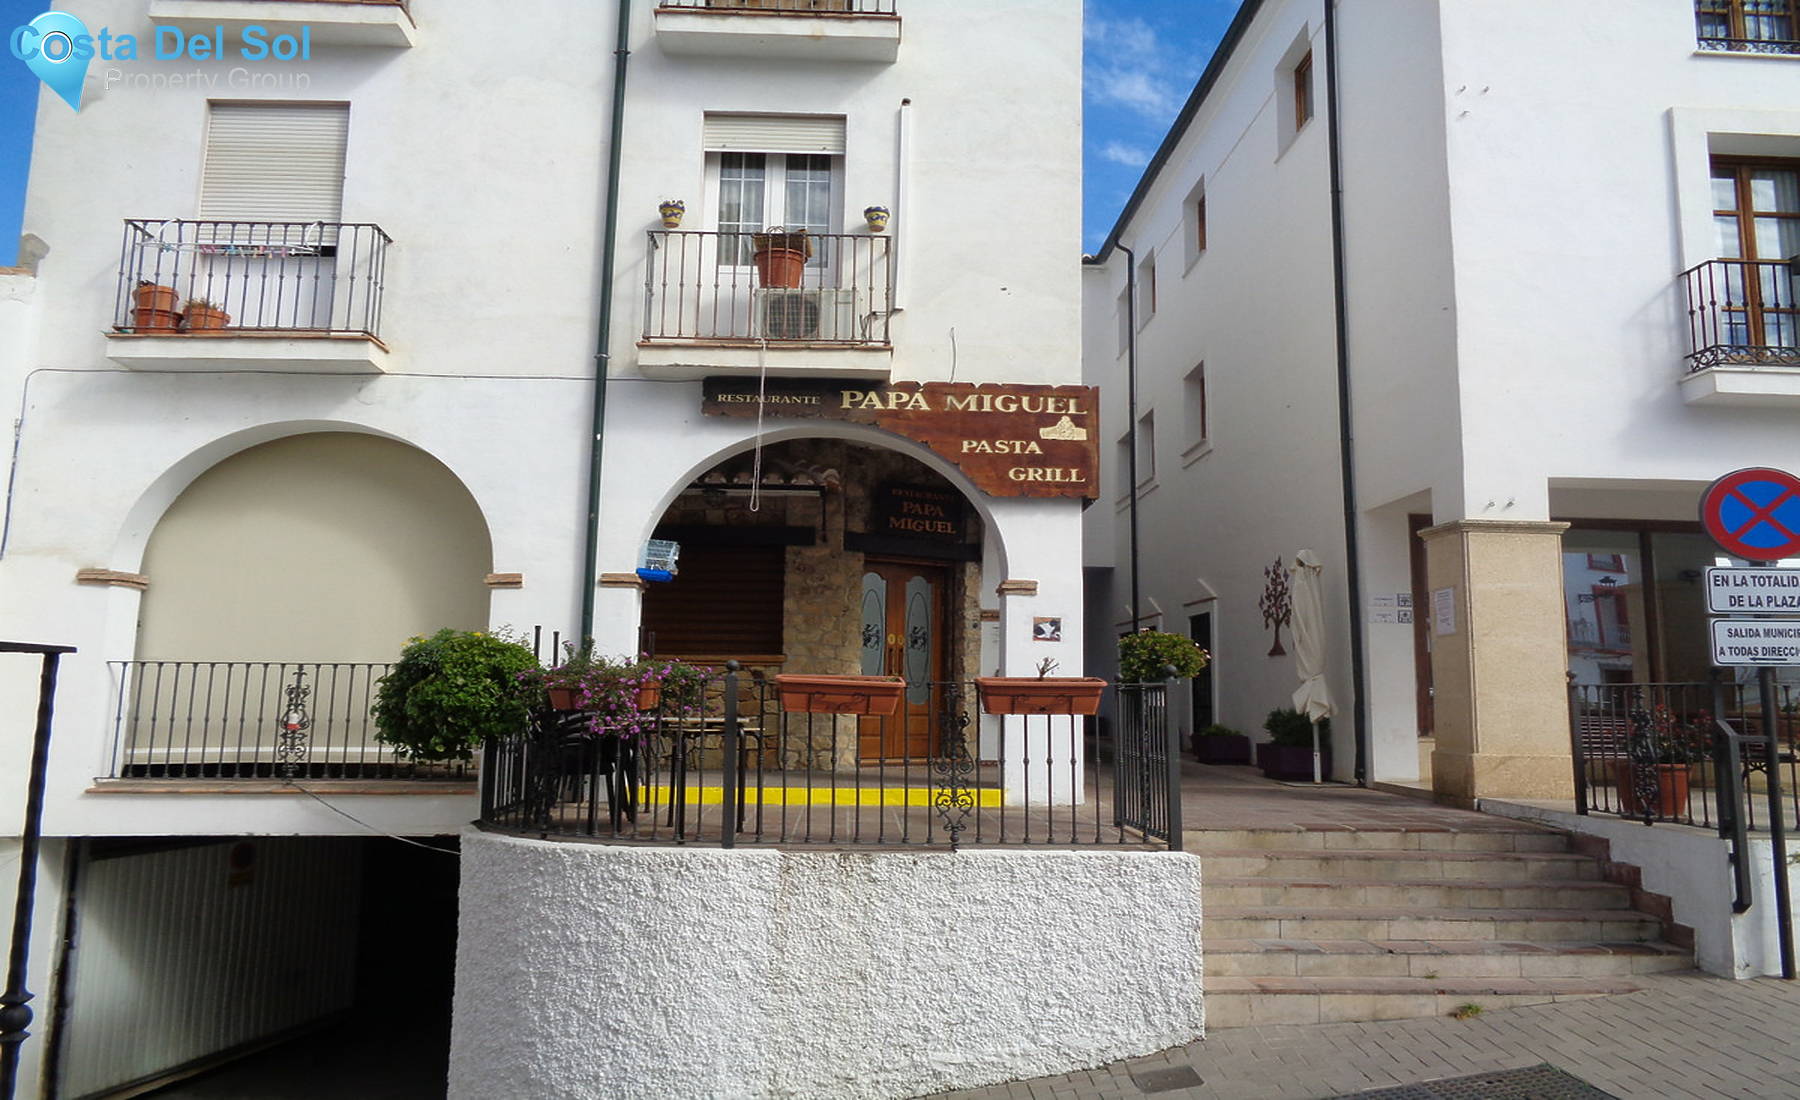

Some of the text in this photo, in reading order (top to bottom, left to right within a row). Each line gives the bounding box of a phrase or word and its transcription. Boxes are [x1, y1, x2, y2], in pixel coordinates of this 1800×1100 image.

[718, 394, 820, 405] RESTAURANTE
[944, 394, 1088, 415] MIGUEL
[961, 440, 1043, 454] PASTA
[1008, 467, 1085, 482] GRILL
[888, 516, 957, 534] MIGUEL
[1713, 575, 1729, 587] EN
[1733, 575, 1748, 587] LA
[1729, 595, 1745, 607] DE
[1748, 595, 1763, 607] LA
[1727, 628, 1761, 638] SALIDA
[1719, 646, 1800, 656] A TODAS DIRECCI
